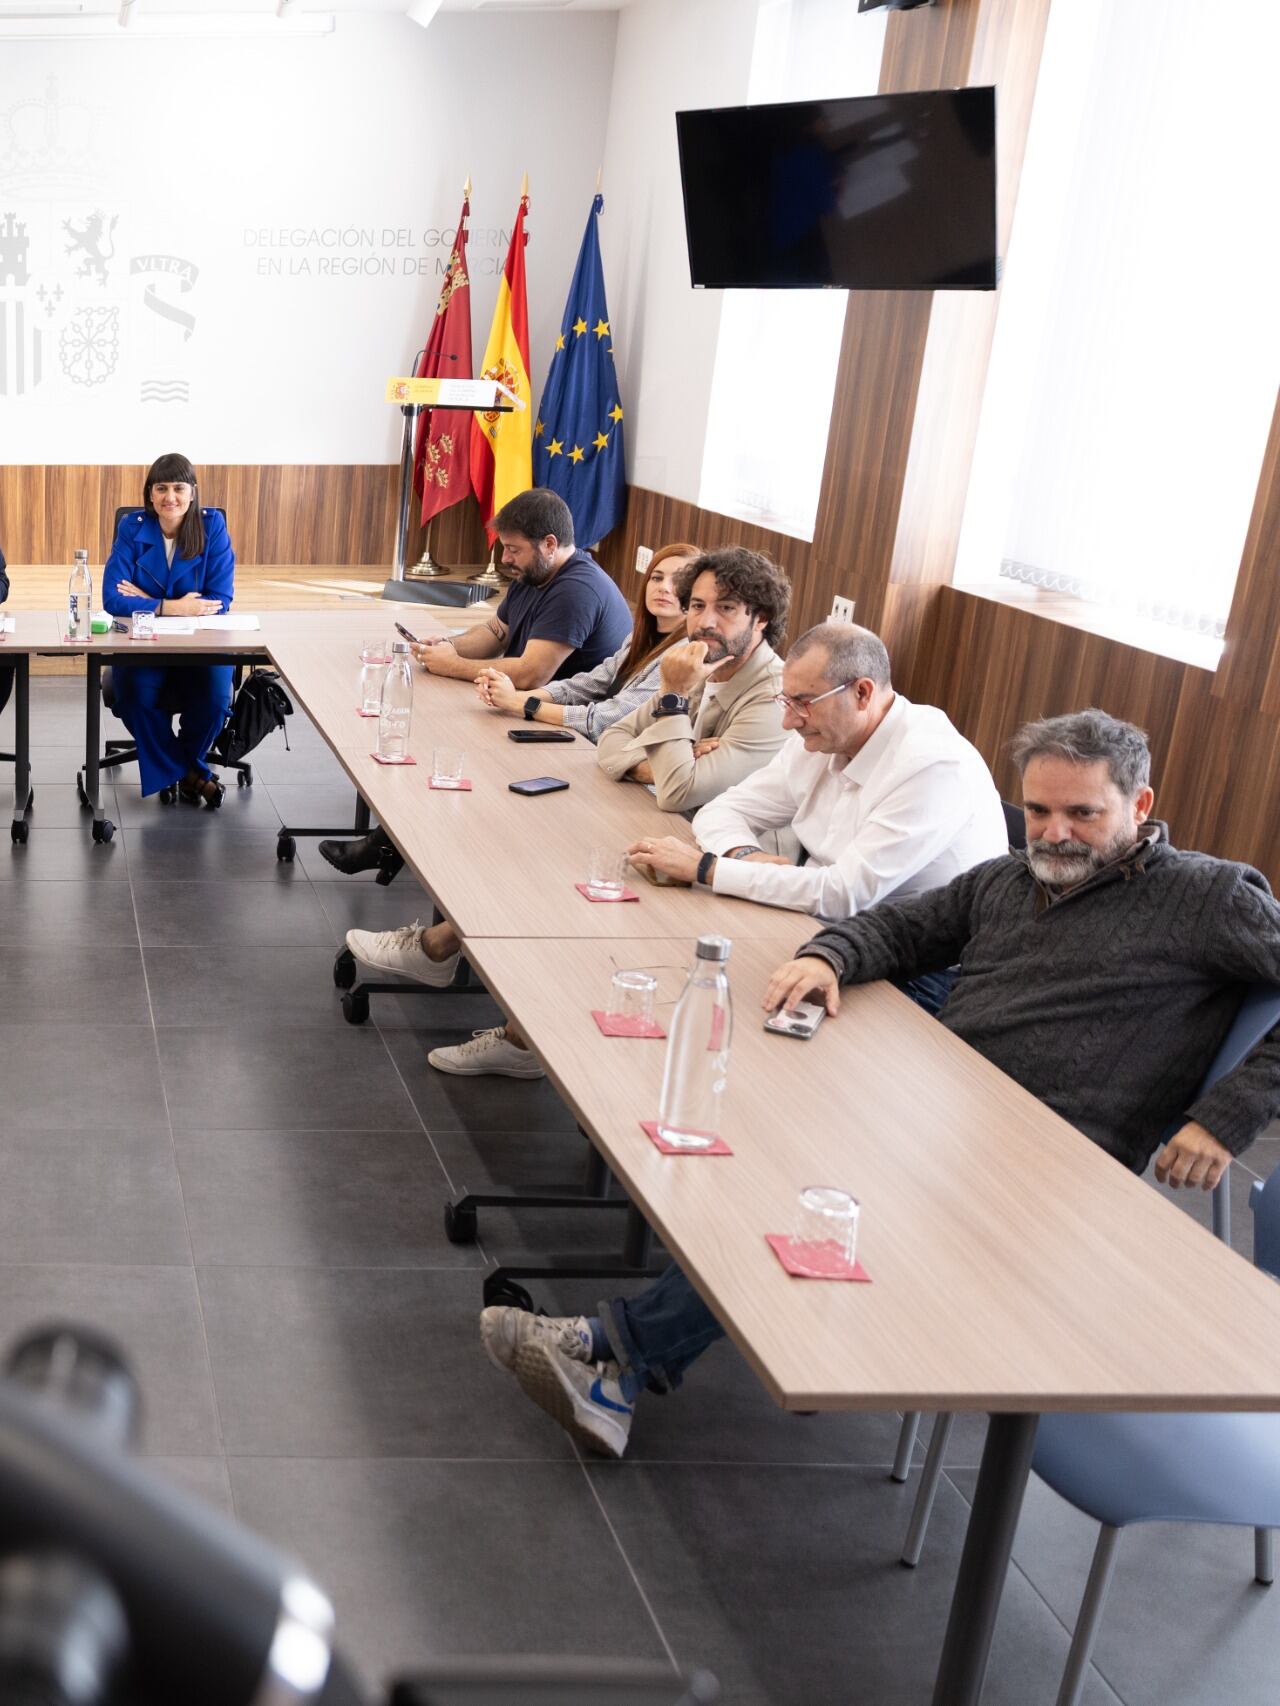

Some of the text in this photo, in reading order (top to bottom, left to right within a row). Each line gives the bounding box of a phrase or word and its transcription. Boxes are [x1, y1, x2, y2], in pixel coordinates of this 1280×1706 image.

[243, 224, 531, 247] DELEGACIÓN DEL GOIERN
[136, 257, 192, 281] VLTRA
[257, 257, 282, 275] EN
[289, 257, 312, 275] LA
[318, 251, 396, 275] REGIÓN
[403, 257, 428, 275] DE
